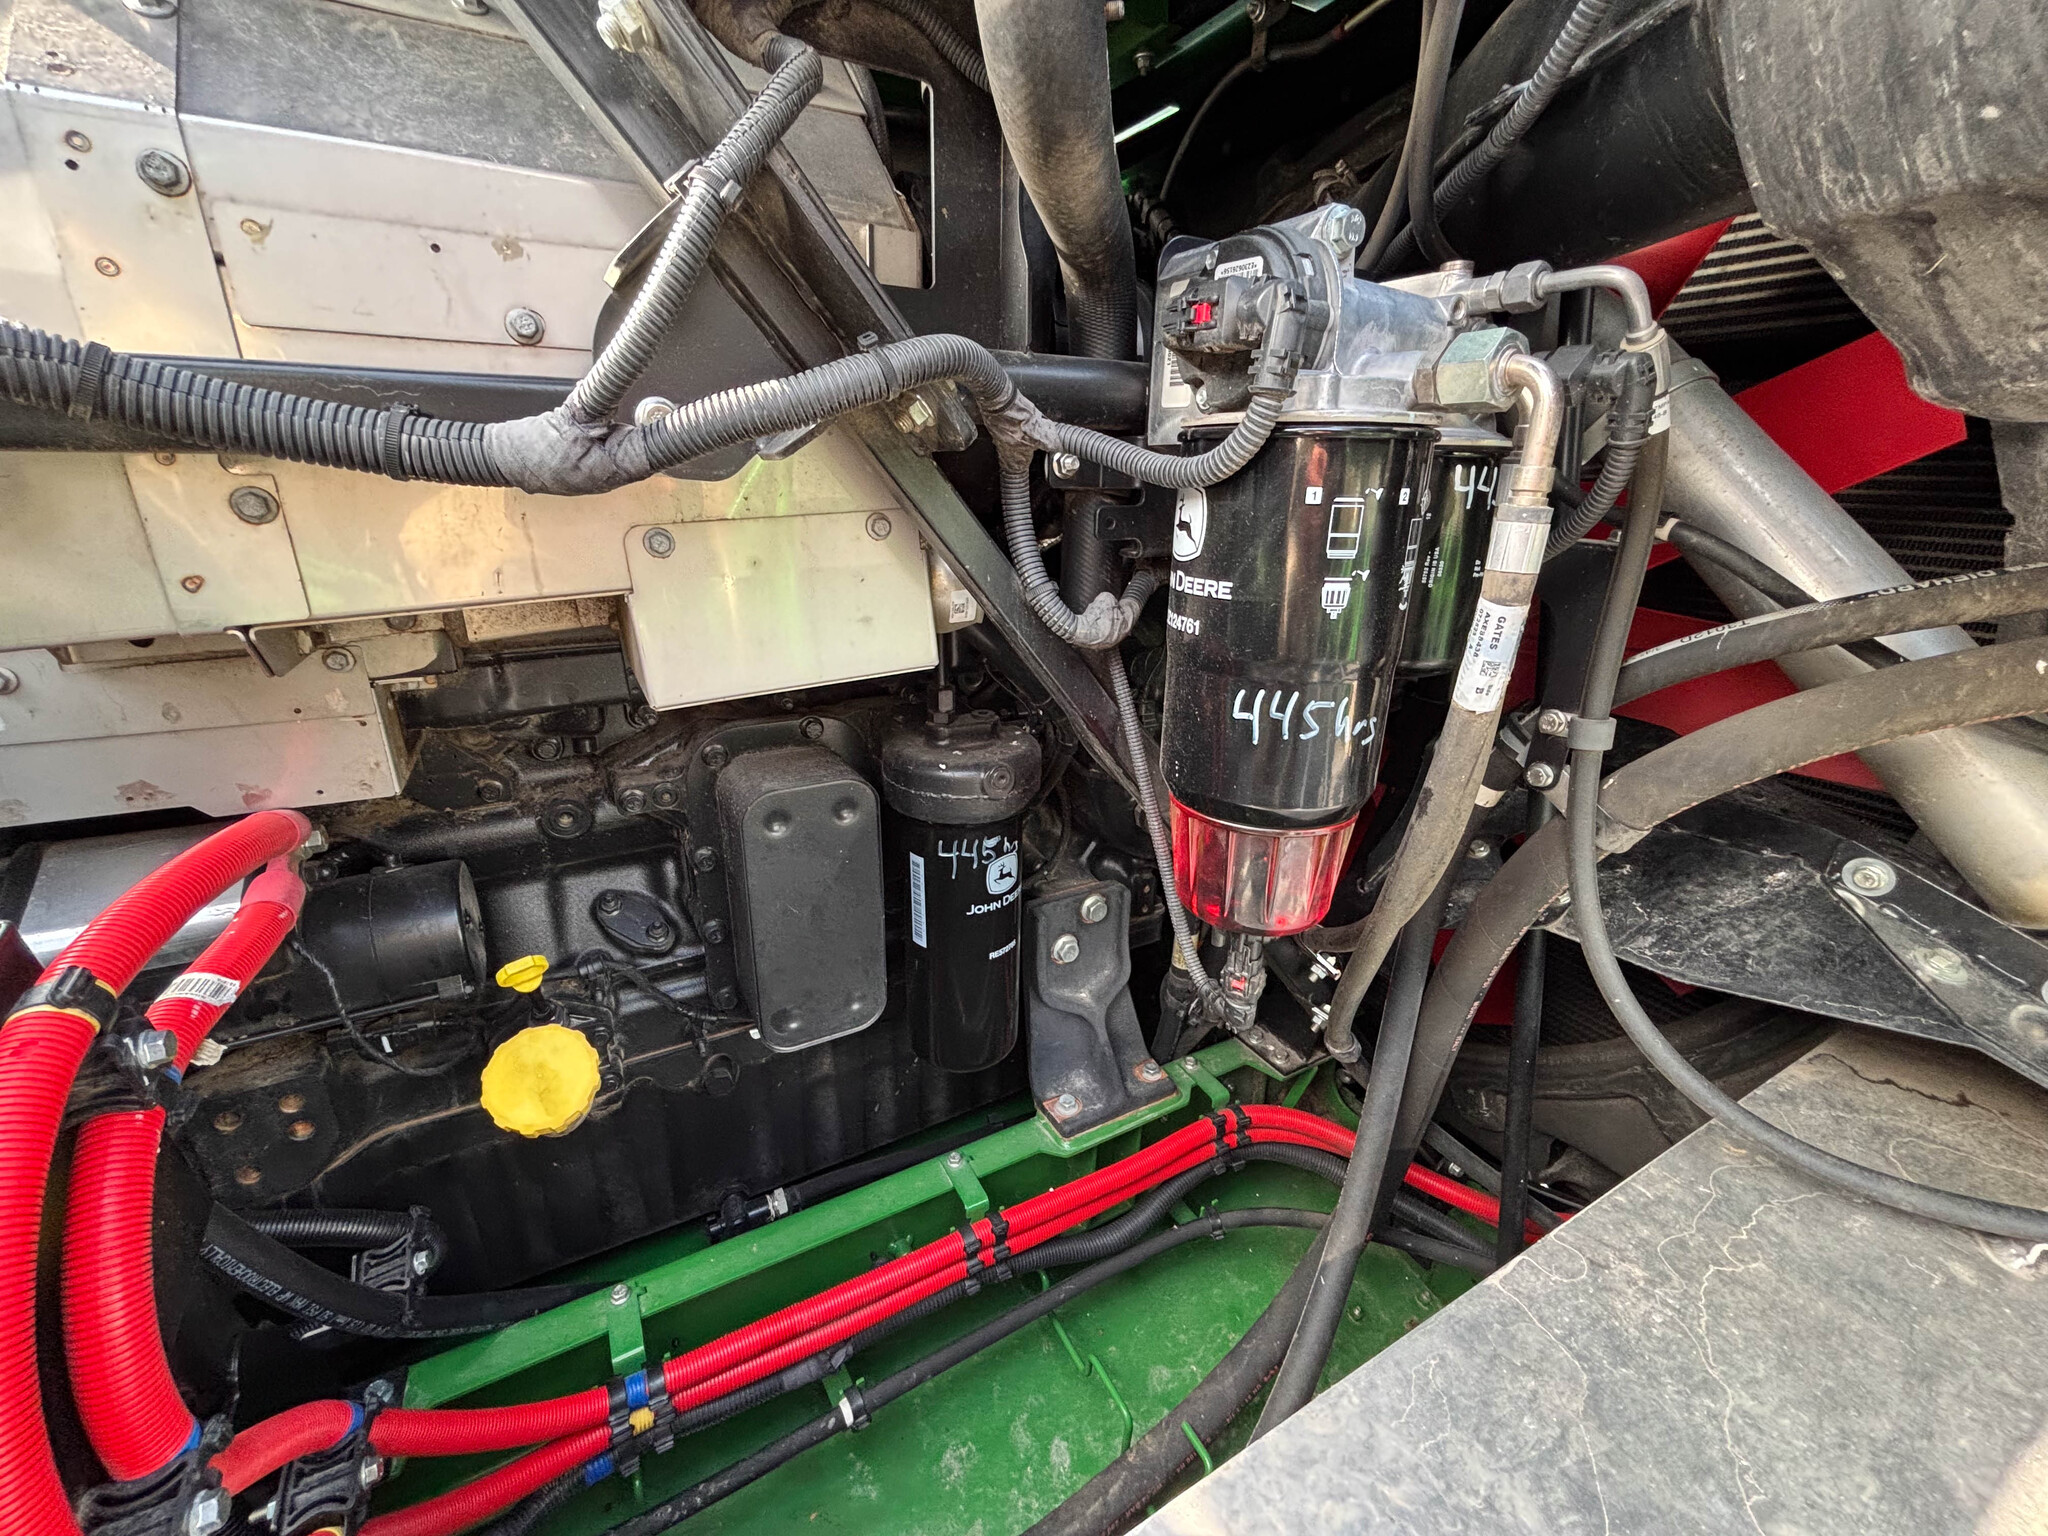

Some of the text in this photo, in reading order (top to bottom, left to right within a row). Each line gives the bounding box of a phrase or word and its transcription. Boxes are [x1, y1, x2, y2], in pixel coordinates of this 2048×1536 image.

[1454, 464, 1498, 511] 44
[1175, 569, 1234, 601] DEERE
[1489, 615, 1507, 651] GATES
[966, 899, 1001, 916] JOHN
